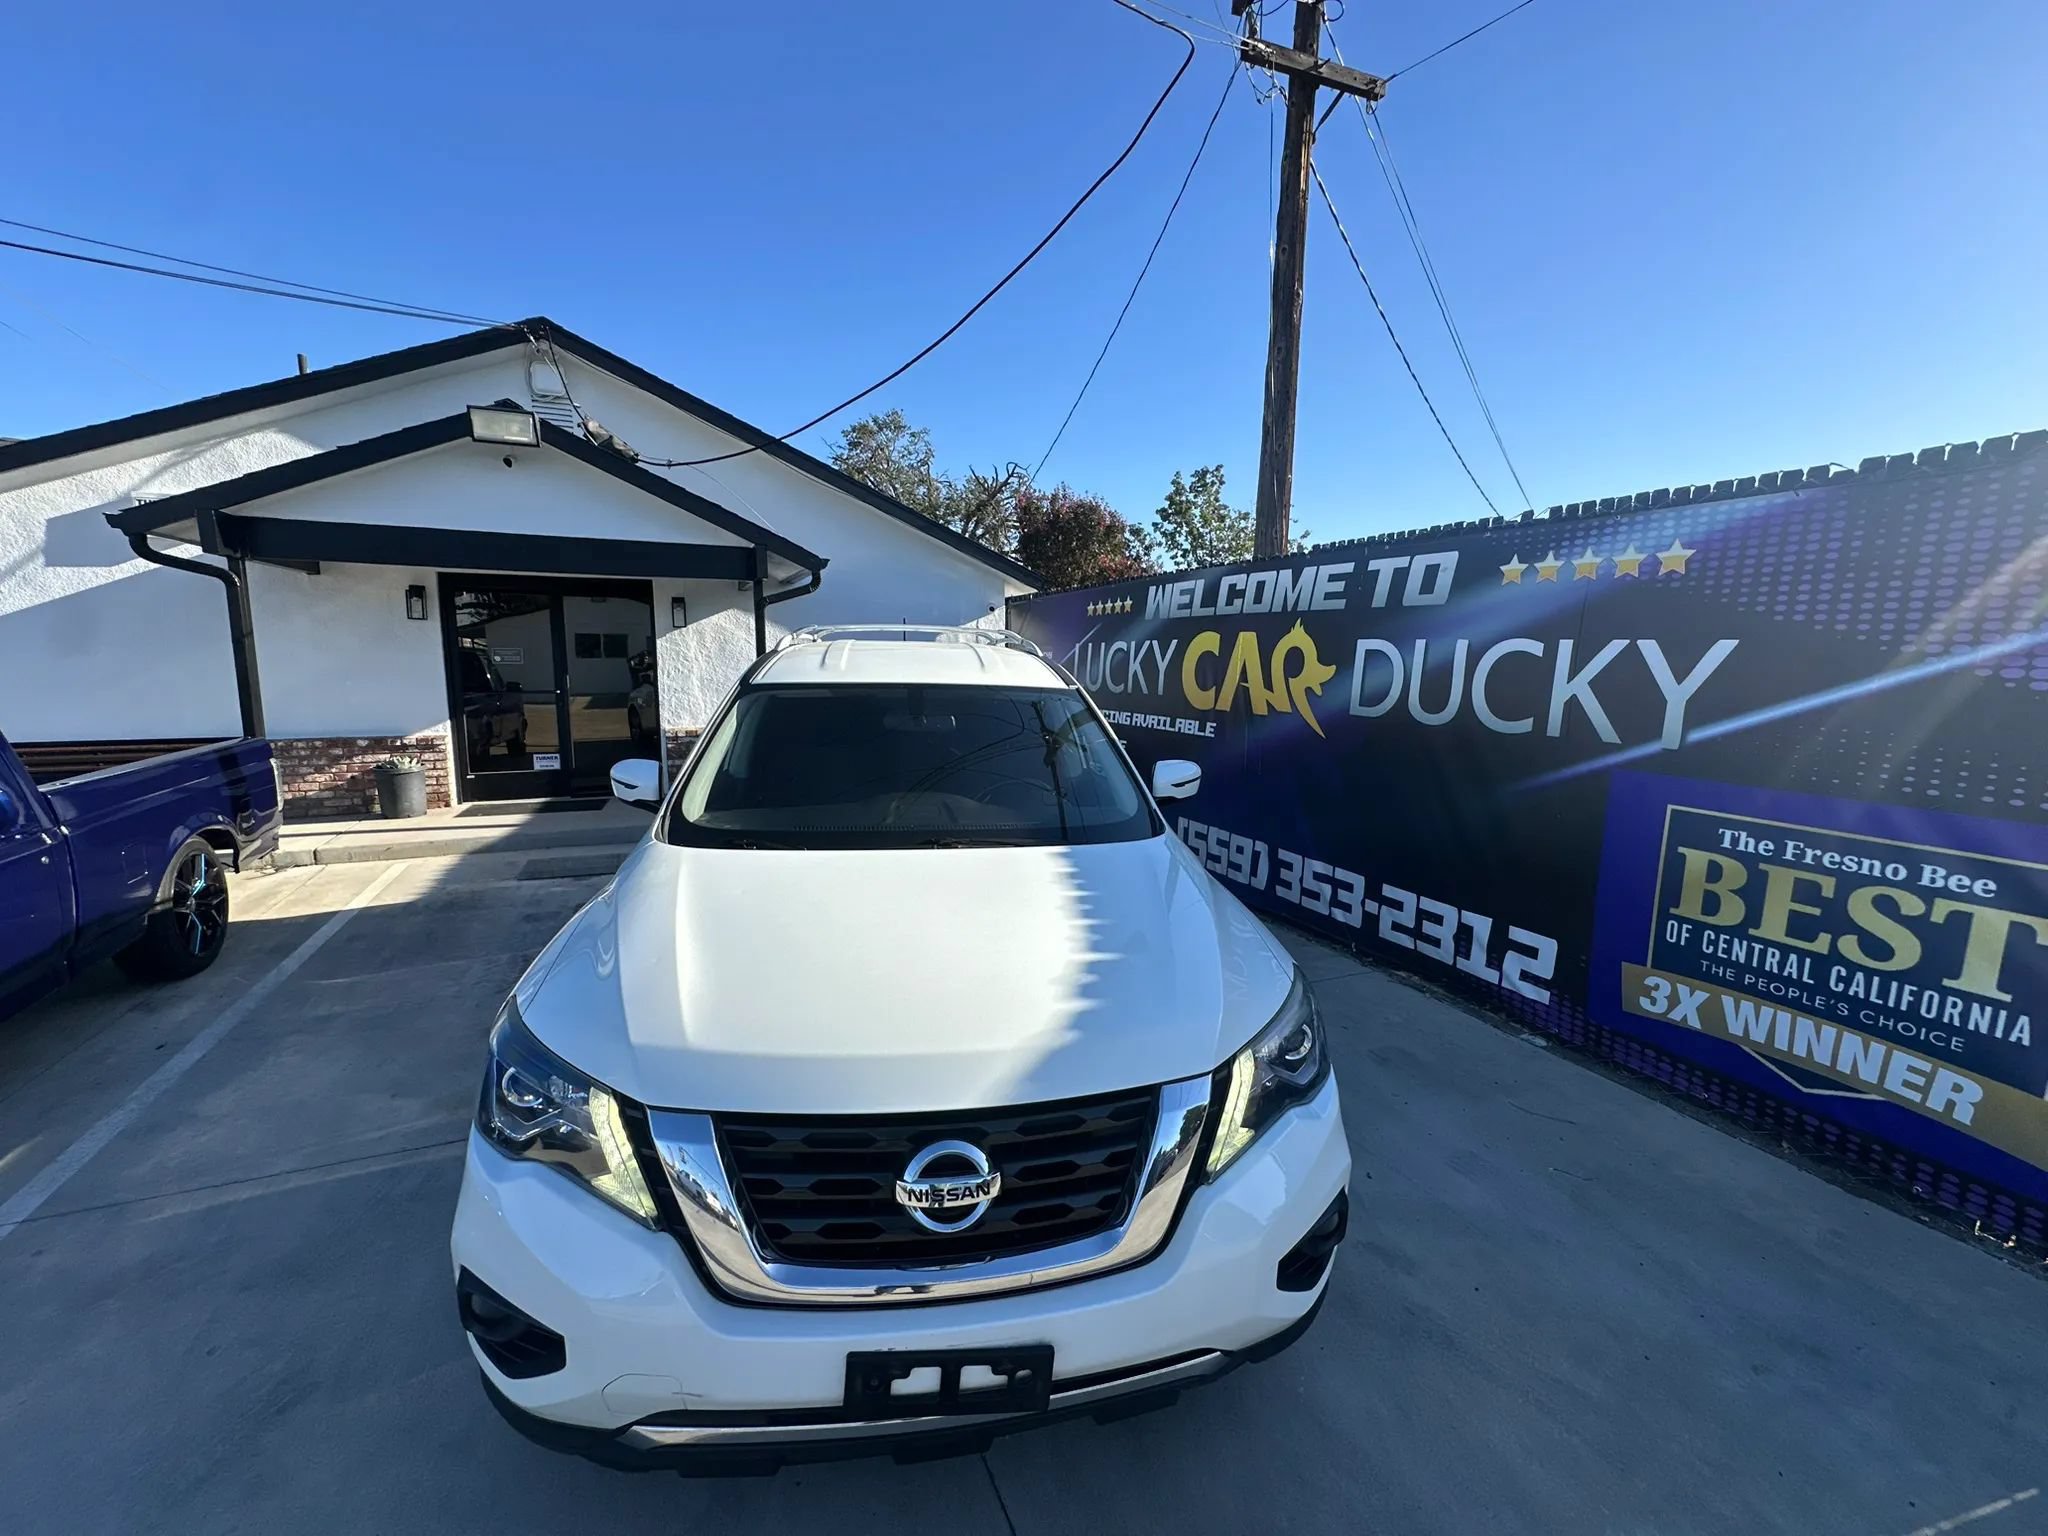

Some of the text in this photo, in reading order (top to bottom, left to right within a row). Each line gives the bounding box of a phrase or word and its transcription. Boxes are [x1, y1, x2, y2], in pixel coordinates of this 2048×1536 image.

[1145, 551, 1459, 620] WELCOME TO
[1132, 713, 1217, 737] AVAILABLE
[1349, 638, 1739, 750] DUCKY
[1718, 828, 1998, 898] The Fresno Bee
[1275, 847, 1558, 1004] 353-2312
[1669, 846, 2048, 1003] BEST
[1665, 920, 2032, 1047] OF CENTRAL CALIFORNIA
[1701, 961, 1966, 1053] THE PEOPLE'S CHOICE
[1639, 976, 1984, 1127] 3X WINNER
[907, 1182, 992, 1203] NISSAN
